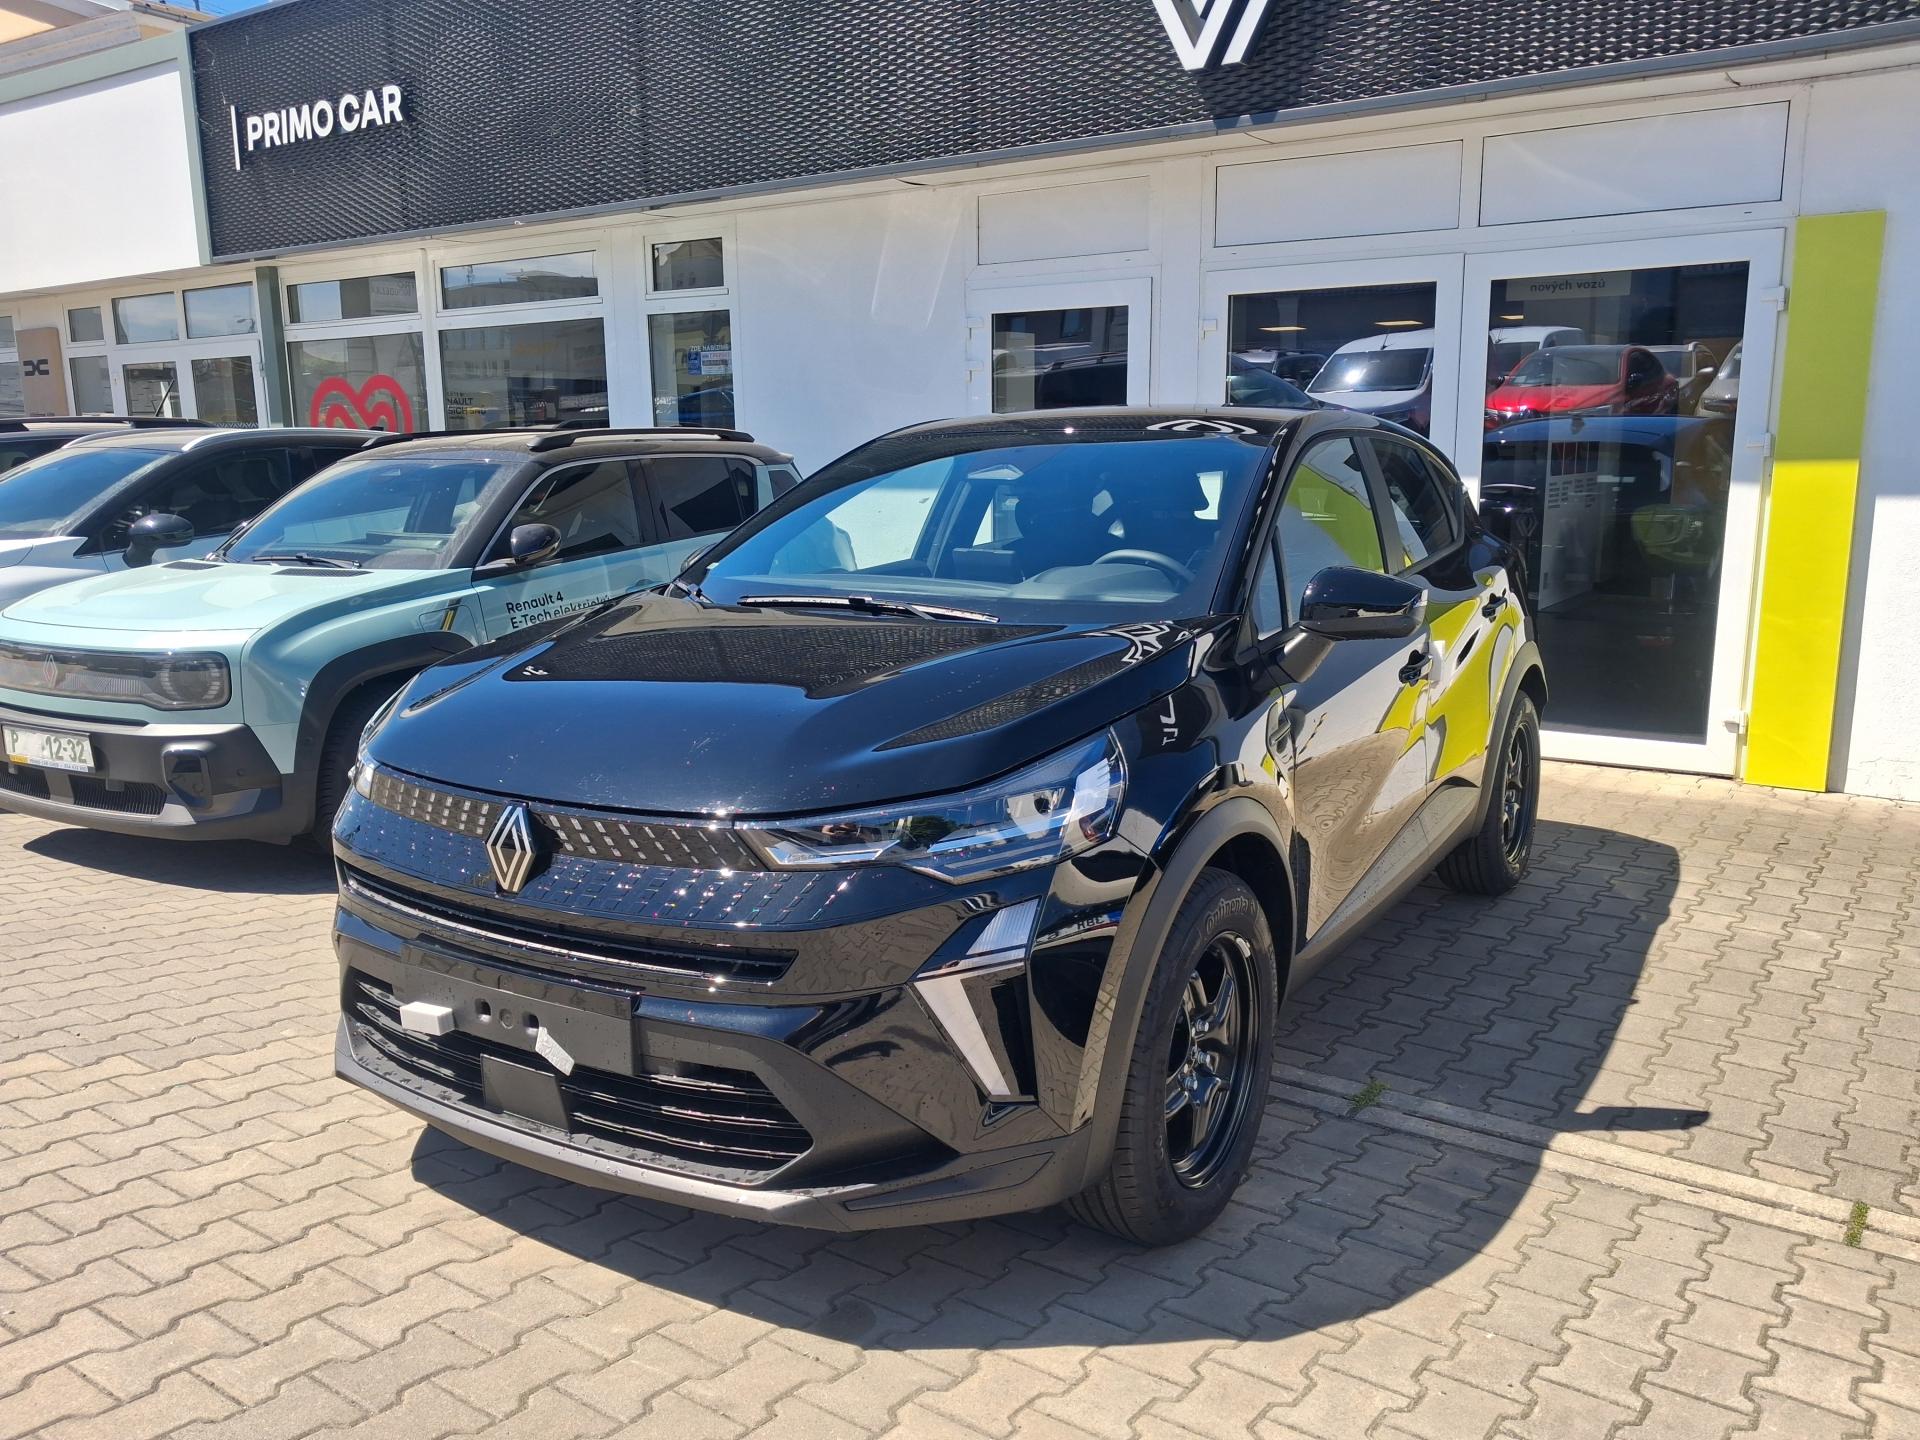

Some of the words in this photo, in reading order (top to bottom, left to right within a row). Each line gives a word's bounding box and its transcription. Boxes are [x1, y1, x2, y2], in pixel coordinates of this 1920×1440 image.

[246, 99, 334, 151] PRIMO
[338, 84, 403, 132] CAR
[1530, 280, 1572, 293] nových
[1576, 279, 1606, 289] vozů
[506, 594, 554, 614] Renault
[556, 591, 564, 602] 4
[510, 609, 552, 629] E-Tech
